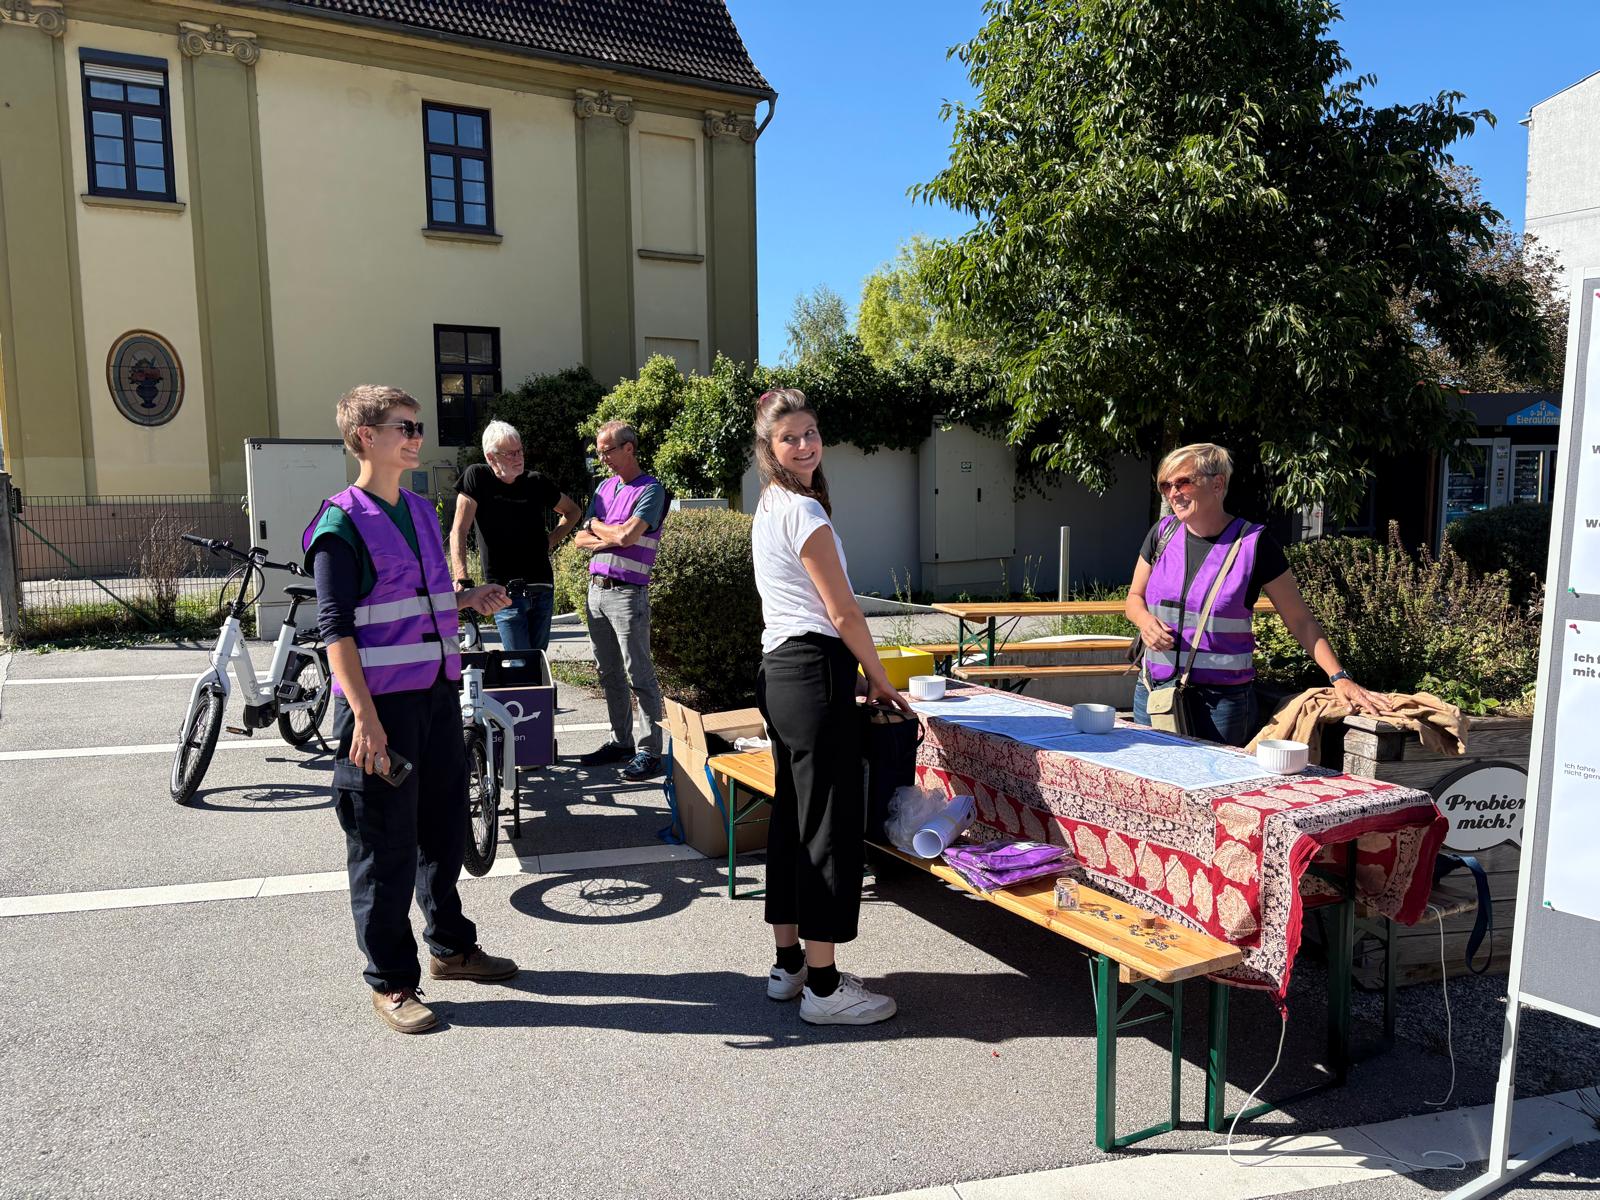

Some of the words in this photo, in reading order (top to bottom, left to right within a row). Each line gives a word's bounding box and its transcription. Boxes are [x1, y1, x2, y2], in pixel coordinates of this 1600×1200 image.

[1516, 415, 1561, 425] Eierautom
[1574, 653, 1595, 663] Ich
[1573, 667, 1596, 678] mit
[1564, 769, 1582, 777] nicht
[1577, 765, 1596, 773] fahre
[1456, 813, 1516, 829] mich!
